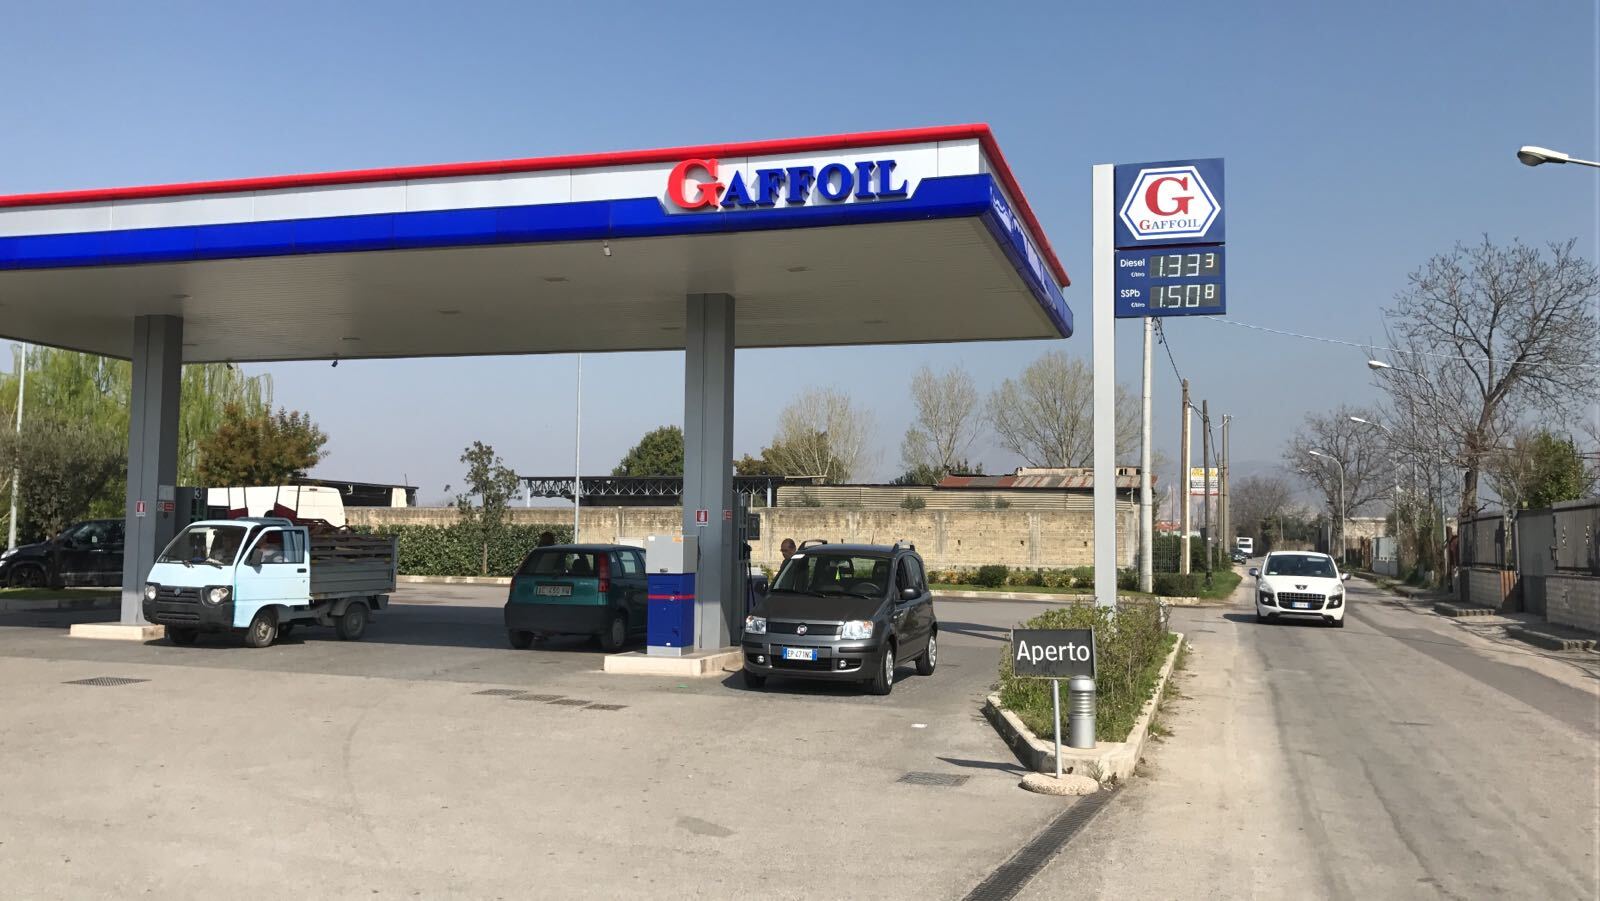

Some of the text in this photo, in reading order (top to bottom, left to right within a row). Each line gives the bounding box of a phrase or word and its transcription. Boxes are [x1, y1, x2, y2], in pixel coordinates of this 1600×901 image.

[668, 158, 908, 209] GAFFOIL
[1145, 176, 1194, 217] G
[1139, 219, 1201, 231] GAFFOIL
[1120, 258, 1146, 268] Diesel
[1120, 289, 1141, 298] SSPb
[1016, 640, 1090, 665] Aperto
